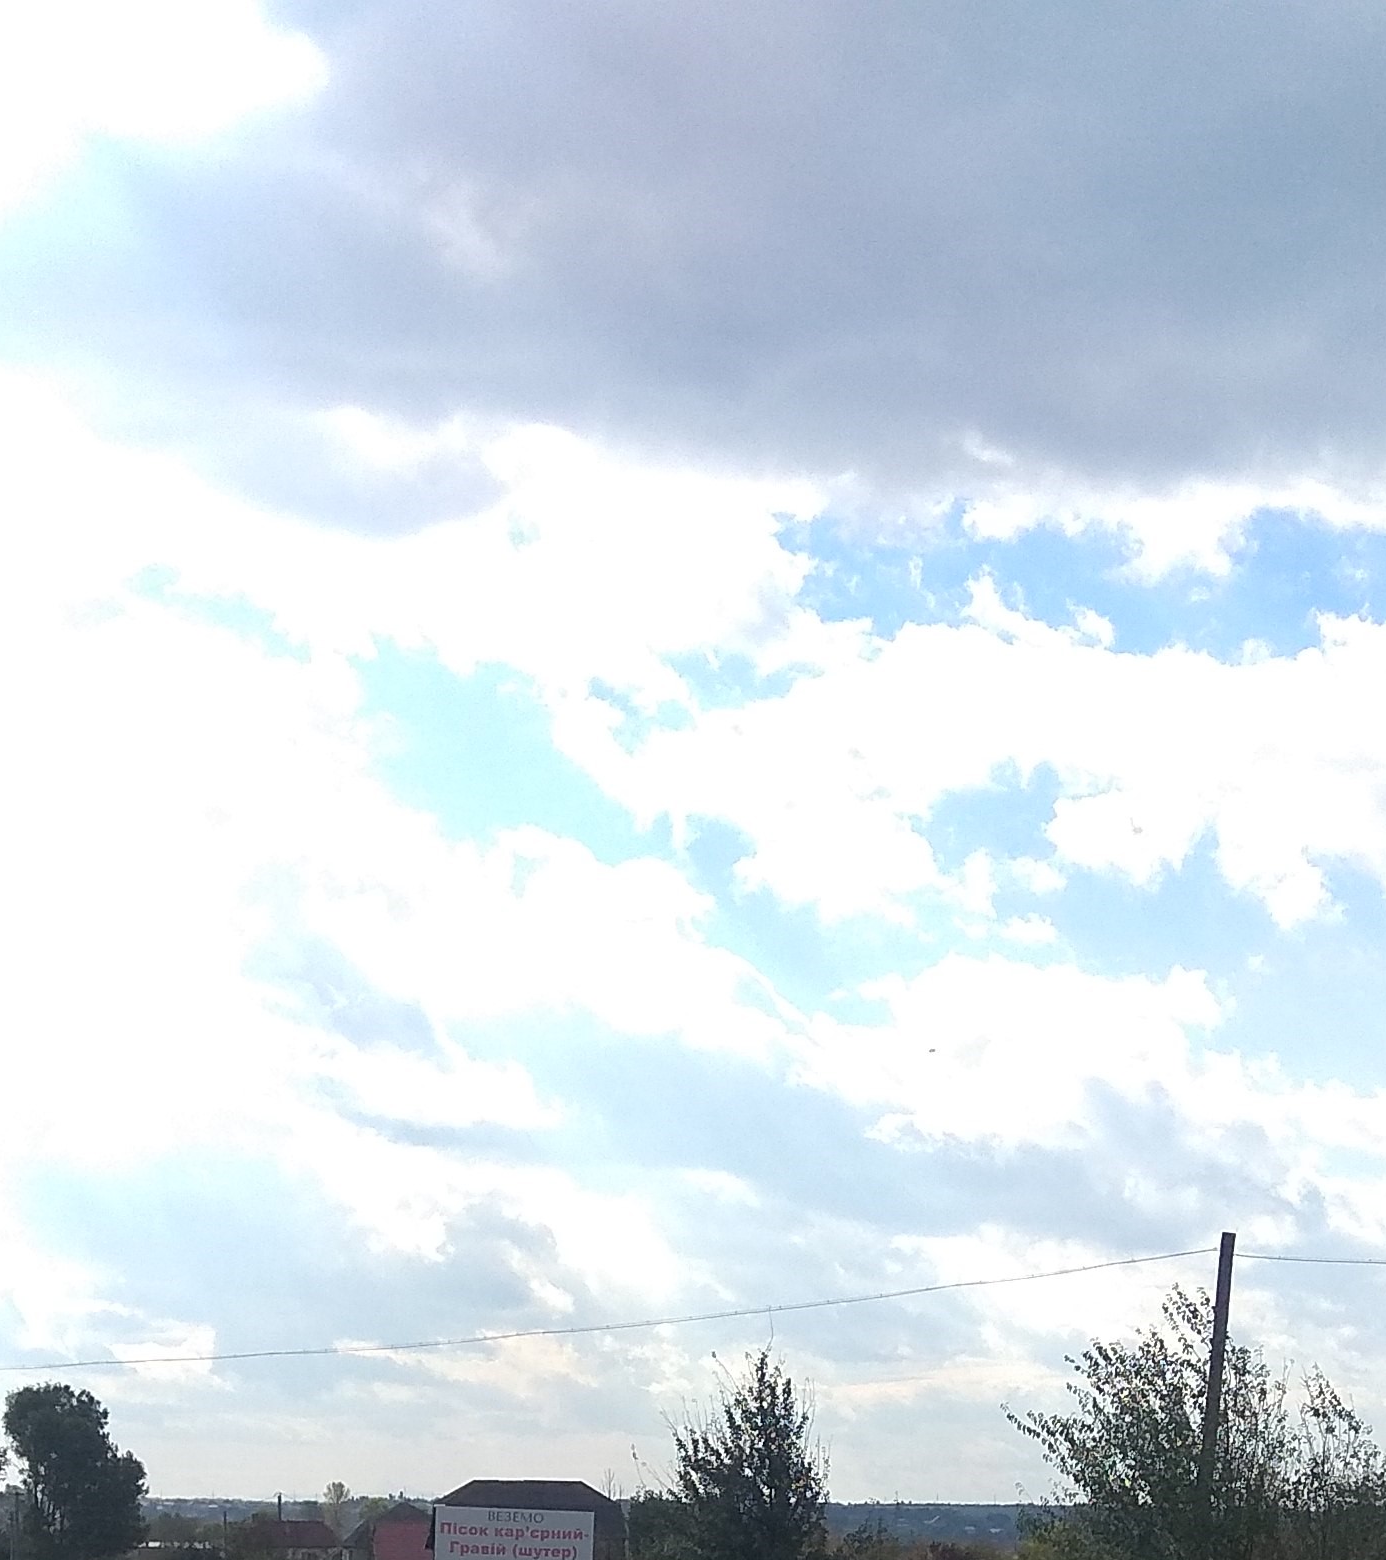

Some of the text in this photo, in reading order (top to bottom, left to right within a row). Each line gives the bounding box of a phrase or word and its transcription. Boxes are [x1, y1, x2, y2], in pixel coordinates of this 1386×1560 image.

[488, 1511, 545, 1523] ВЕЗЕМО
[440, 1522, 489, 1537] Пісок
[449, 1541, 578, 1560] Гравій (шутер)
